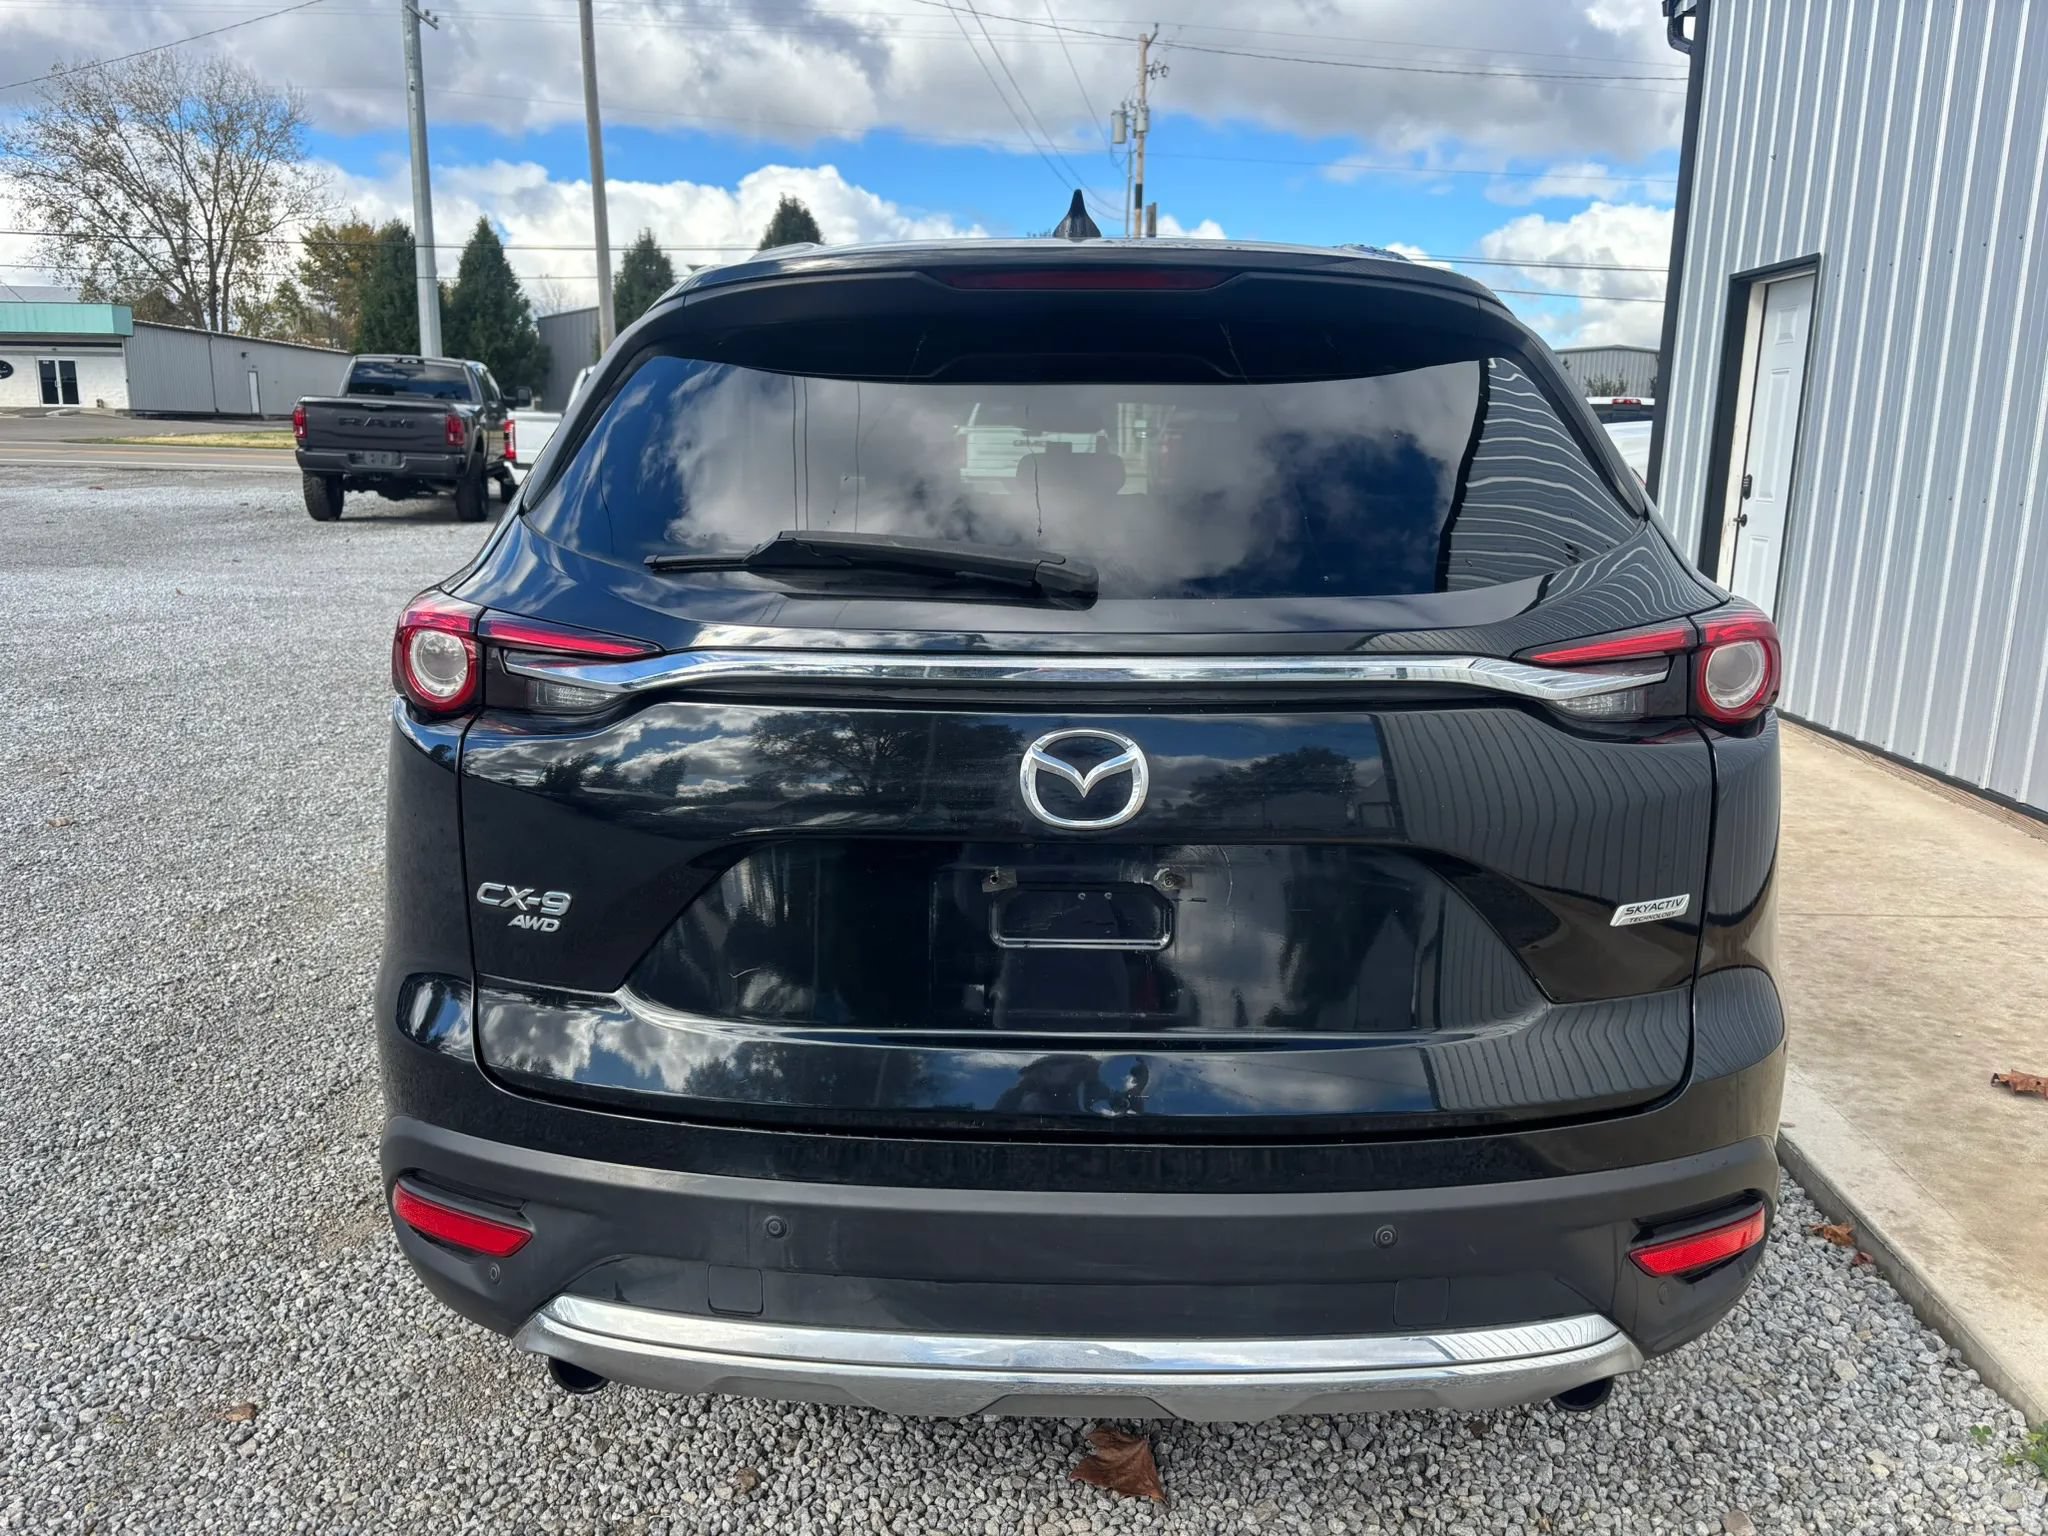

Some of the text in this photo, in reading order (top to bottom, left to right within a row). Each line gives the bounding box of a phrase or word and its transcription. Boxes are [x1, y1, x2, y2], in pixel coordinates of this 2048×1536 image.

[338, 415, 416, 429] RAM
[476, 882, 571, 916] CX-9
[1624, 898, 1684, 916] SKYACTIV
[507, 914, 561, 933] AWD
[1628, 910, 1677, 923] TECHNOLOGY
